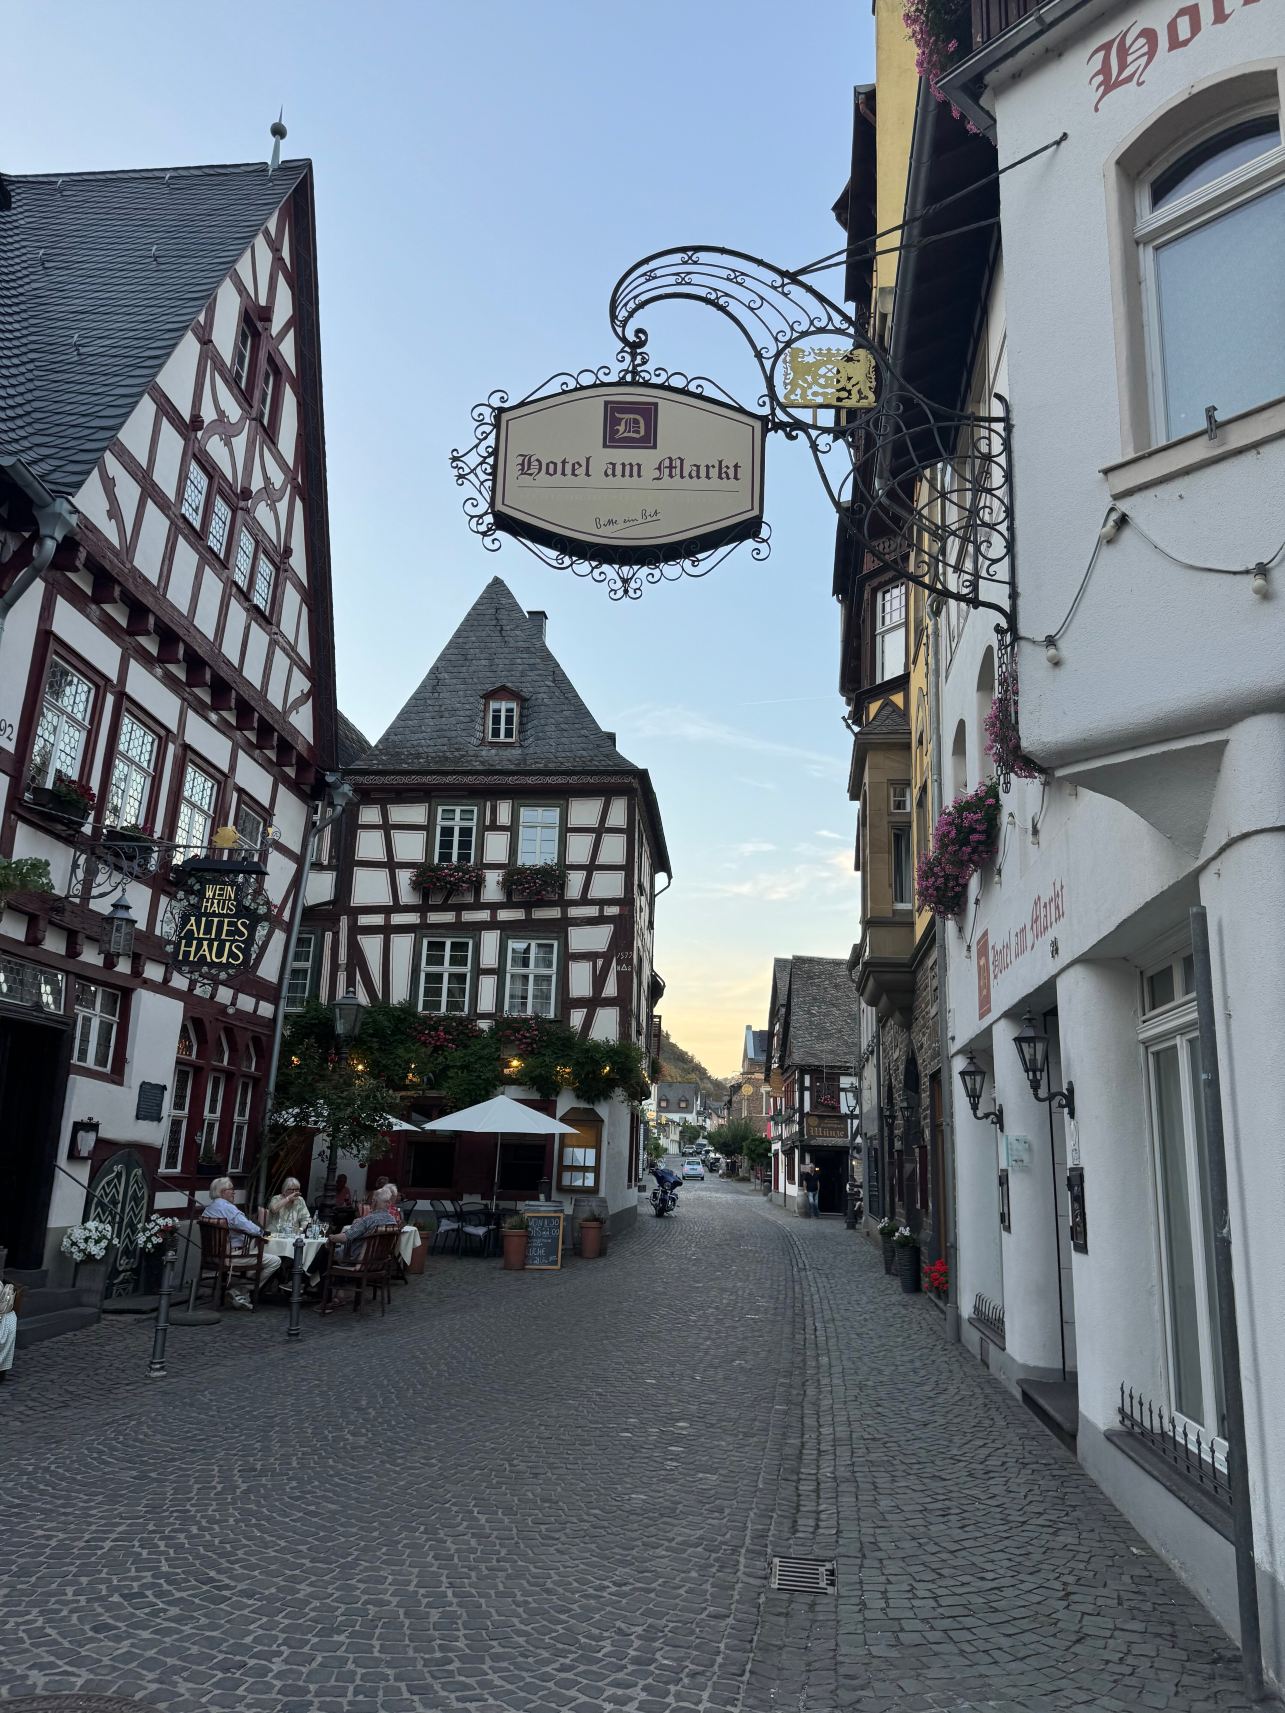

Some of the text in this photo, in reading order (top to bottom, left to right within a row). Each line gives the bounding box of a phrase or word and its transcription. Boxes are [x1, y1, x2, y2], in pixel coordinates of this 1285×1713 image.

[614, 411, 645, 439] D
[516, 453, 741, 481] Hotel am Markt
[595, 508, 661, 529] Bitte ein Bit
[205, 885, 236, 900] WEIN
[201, 899, 237, 914] HAUS
[180, 916, 250, 941] ALTES
[992, 876, 1065, 986] Hotel am Markt
[178, 939, 245, 965] HAUS
